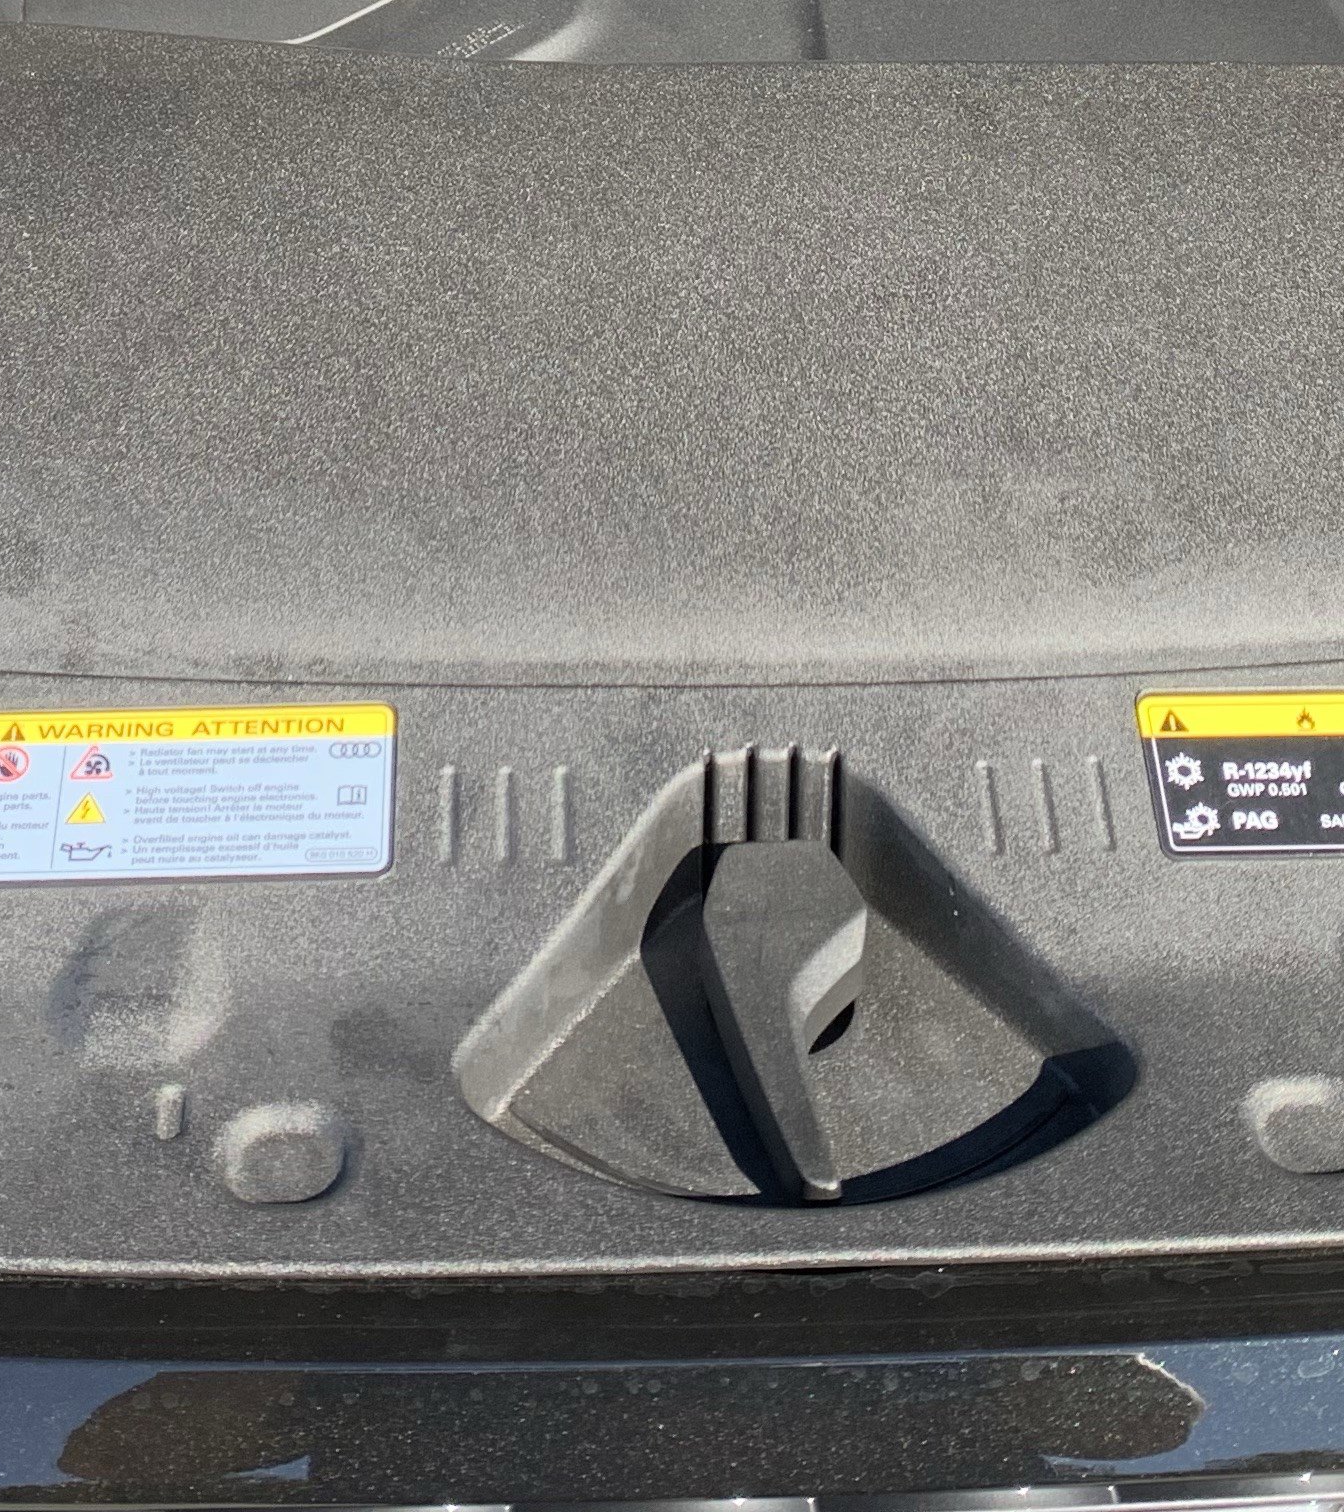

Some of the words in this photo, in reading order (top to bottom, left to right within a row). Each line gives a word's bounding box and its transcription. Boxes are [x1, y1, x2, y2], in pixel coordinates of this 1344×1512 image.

[37, 720, 175, 740] WARNING
[191, 716, 346, 736] ATTENTION
[140, 747, 184, 757] Radiator
[206, 746, 229, 757] may
[231, 746, 255, 756] start
[270, 745, 289, 755] any
[139, 757, 152, 767] Le
[1222, 760, 1312, 782] R-1234yf
[136, 786, 161, 796] High
[210, 784, 244, 794] Switch
[248, 783, 263, 793] off
[264, 783, 300, 794] engine
[1227, 783, 1265, 798] GWP
[1268, 782, 1308, 797] 0.501
[265, 802, 303, 811] moteur
[10, 822, 49, 830] moteur
[1232, 810, 1279, 830] PAG
[187, 833, 222, 844] engine
